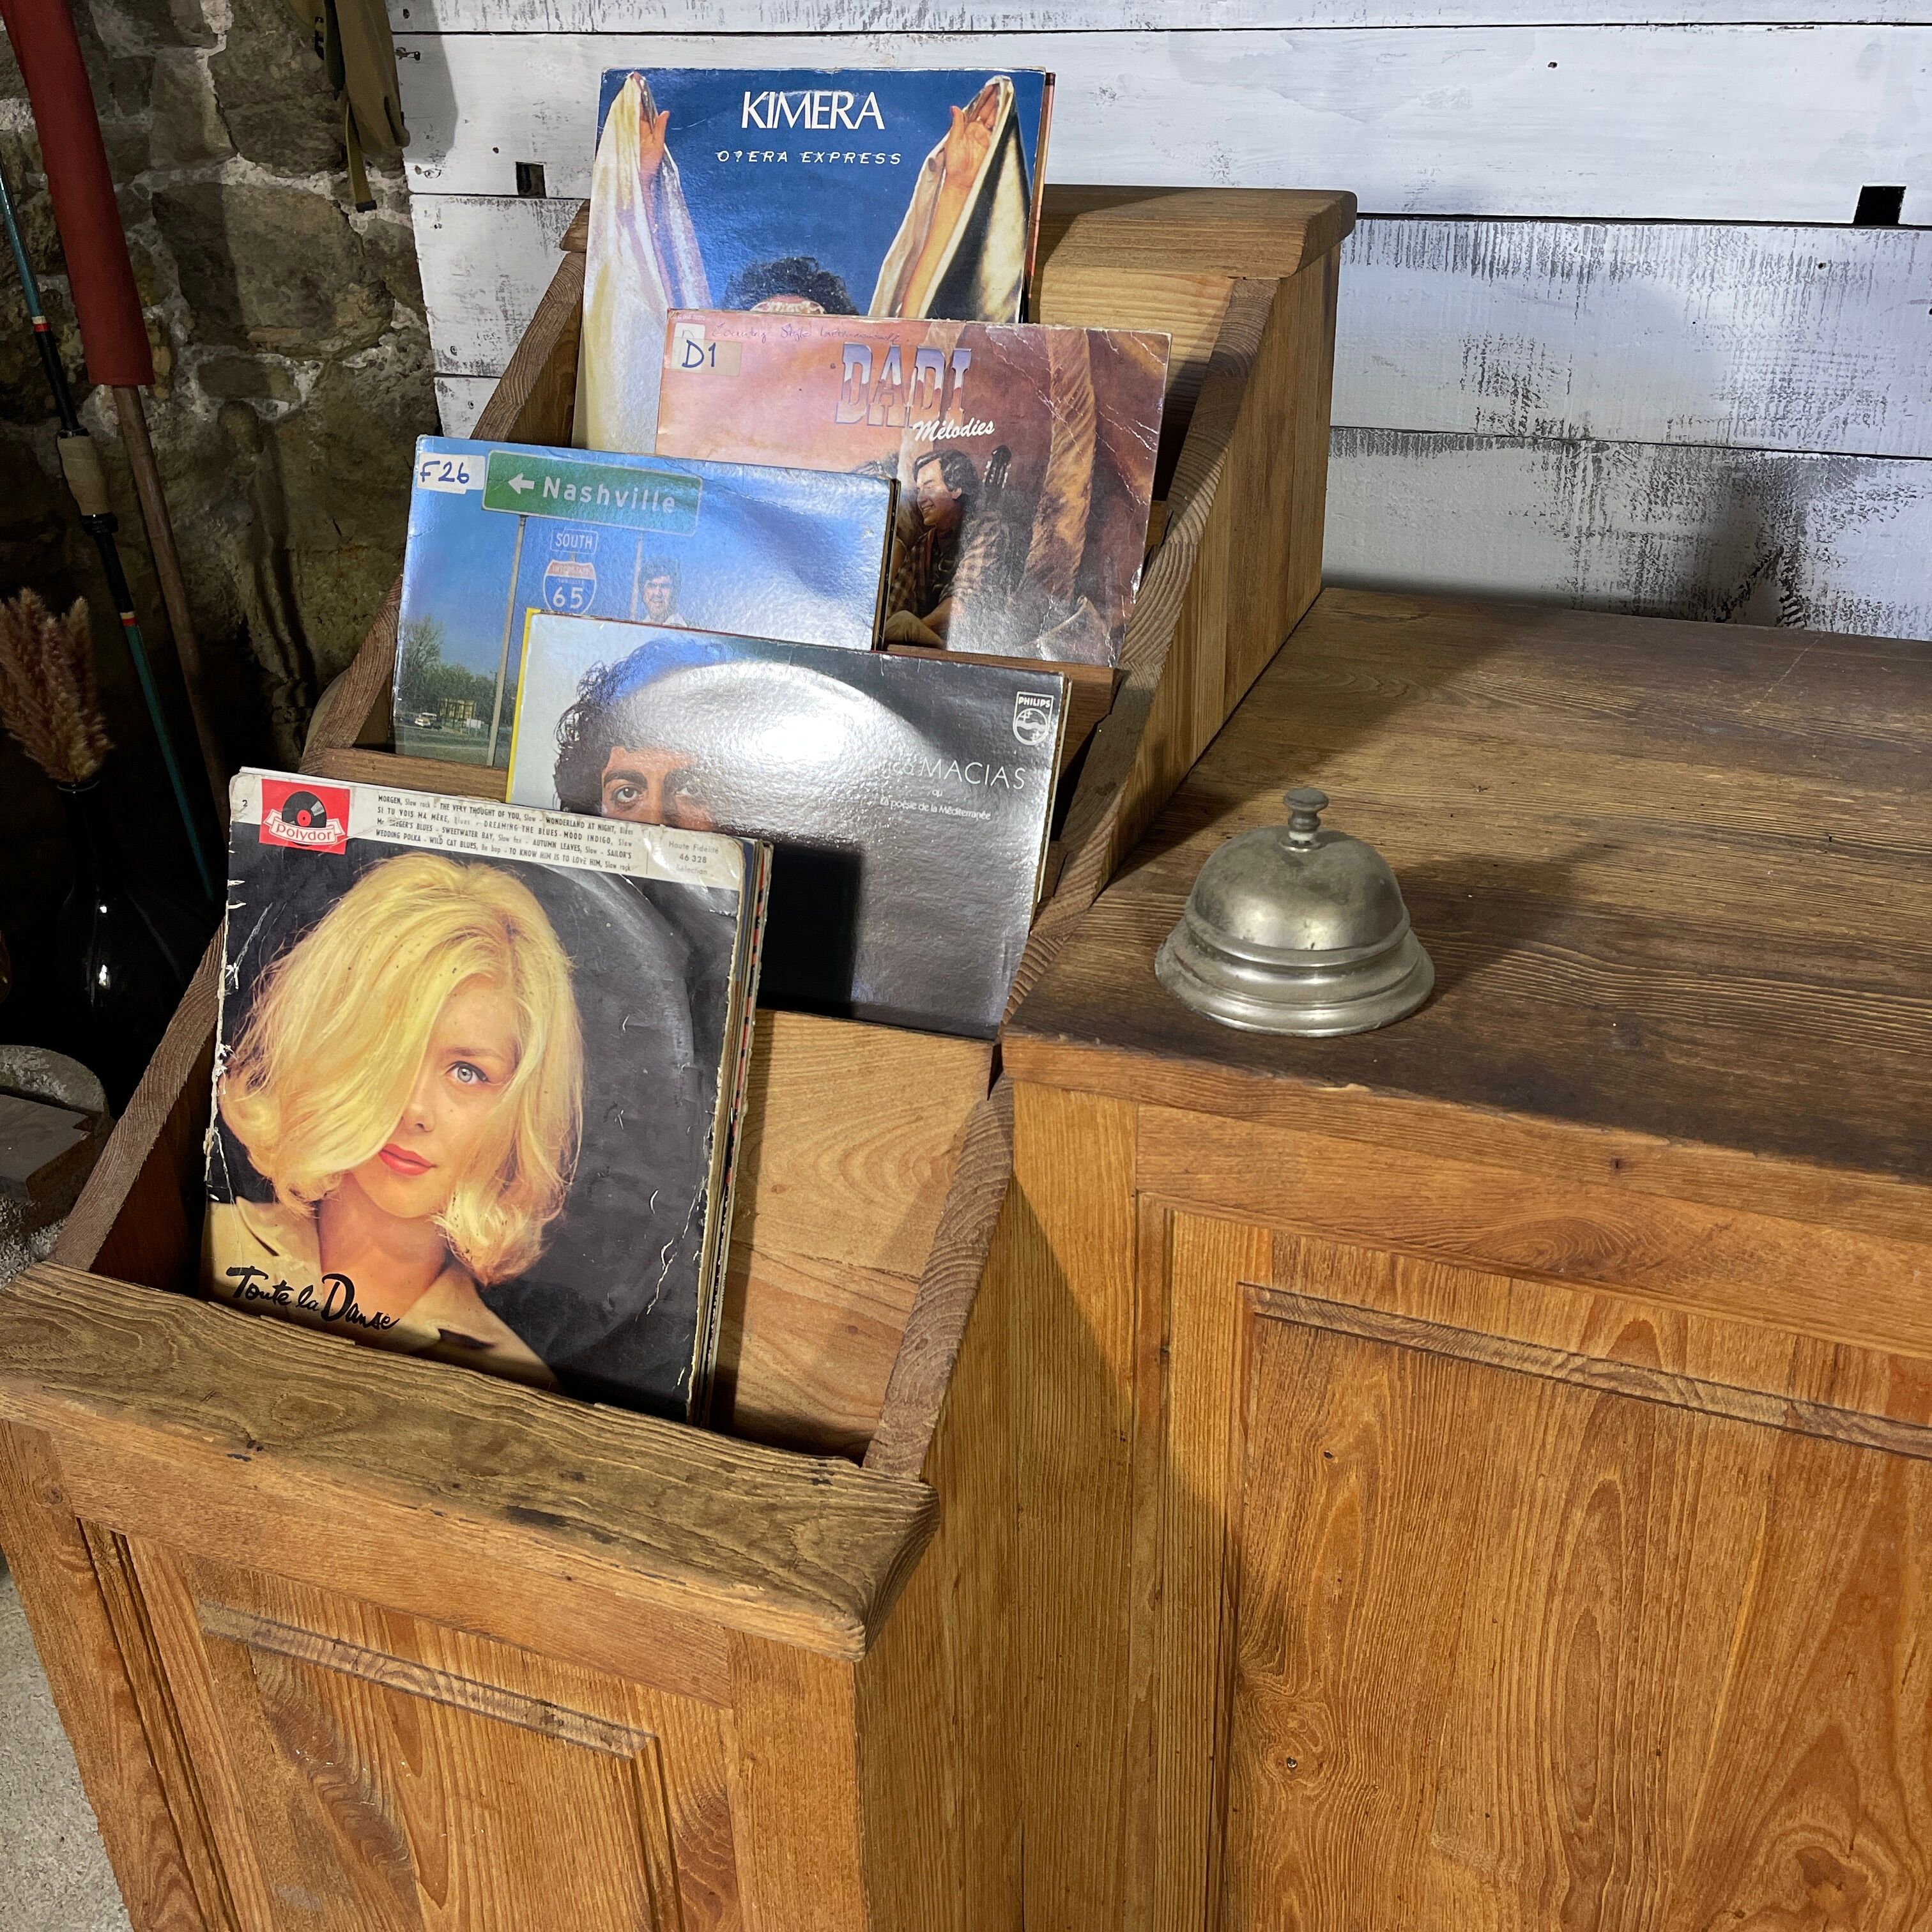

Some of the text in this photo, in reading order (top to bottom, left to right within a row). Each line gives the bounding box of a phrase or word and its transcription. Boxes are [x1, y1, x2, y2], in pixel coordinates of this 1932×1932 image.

[741, 91, 885, 130] KIMERA
[800, 151, 901, 165] EXPRESS
[682, 339, 716, 368] D1
[835, 342, 972, 429] DADI
[912, 417, 995, 442] Mélodies
[419, 461, 470, 484] F26
[543, 476, 675, 513] Nashville
[555, 533, 593, 549] SOUTH
[553, 586, 583, 609] 65
[1018, 696, 1051, 709] PHILIPS
[919, 756, 1026, 790] MACIAS
[378, 795, 402, 806] MORGEN,
[452, 804, 466, 813] VERY
[470, 807, 495, 816] THOUGHT
[508, 811, 521, 821] YOU,
[546, 816, 585, 829] WONDERLAND
[597, 825, 616, 834] NIGHT,
[918, 802, 929, 811] de
[931, 804, 937, 813] la
[275, 823, 332, 841] polydor
[399, 809, 413, 818] VOIS
[484, 820, 518, 831] DREAMING
[522, 825, 533, 833] THE
[539, 827, 557, 837] BLUES
[564, 831, 582, 840] MOOD
[587, 834, 613, 845] INDIGO,
[376, 829, 401, 839] WEDDING
[403, 833, 421, 841] POLKA
[429, 836, 443, 845] WILD
[460, 841, 479, 850] BLUES,
[491, 845, 501, 854] bop
[519, 849, 537, 857] KNOW
[540, 851, 551, 859] HIM
[572, 856, 586, 864] LOVE
[589, 859, 602, 868] HIM,
[605, 861, 617, 869] Slow
[442, 827, 478, 838] SWEETWATER
[482, 832, 494, 841] BAY,
[533, 839, 556, 848] AUTUMN
[560, 843, 582, 854] LEAVES,
[607, 849, 632, 859] SAILOR'S
[669, 841, 689, 850] Haute
[679, 853, 707, 863] 46 328
[226, 1266, 401, 1331] Toute la Danse
